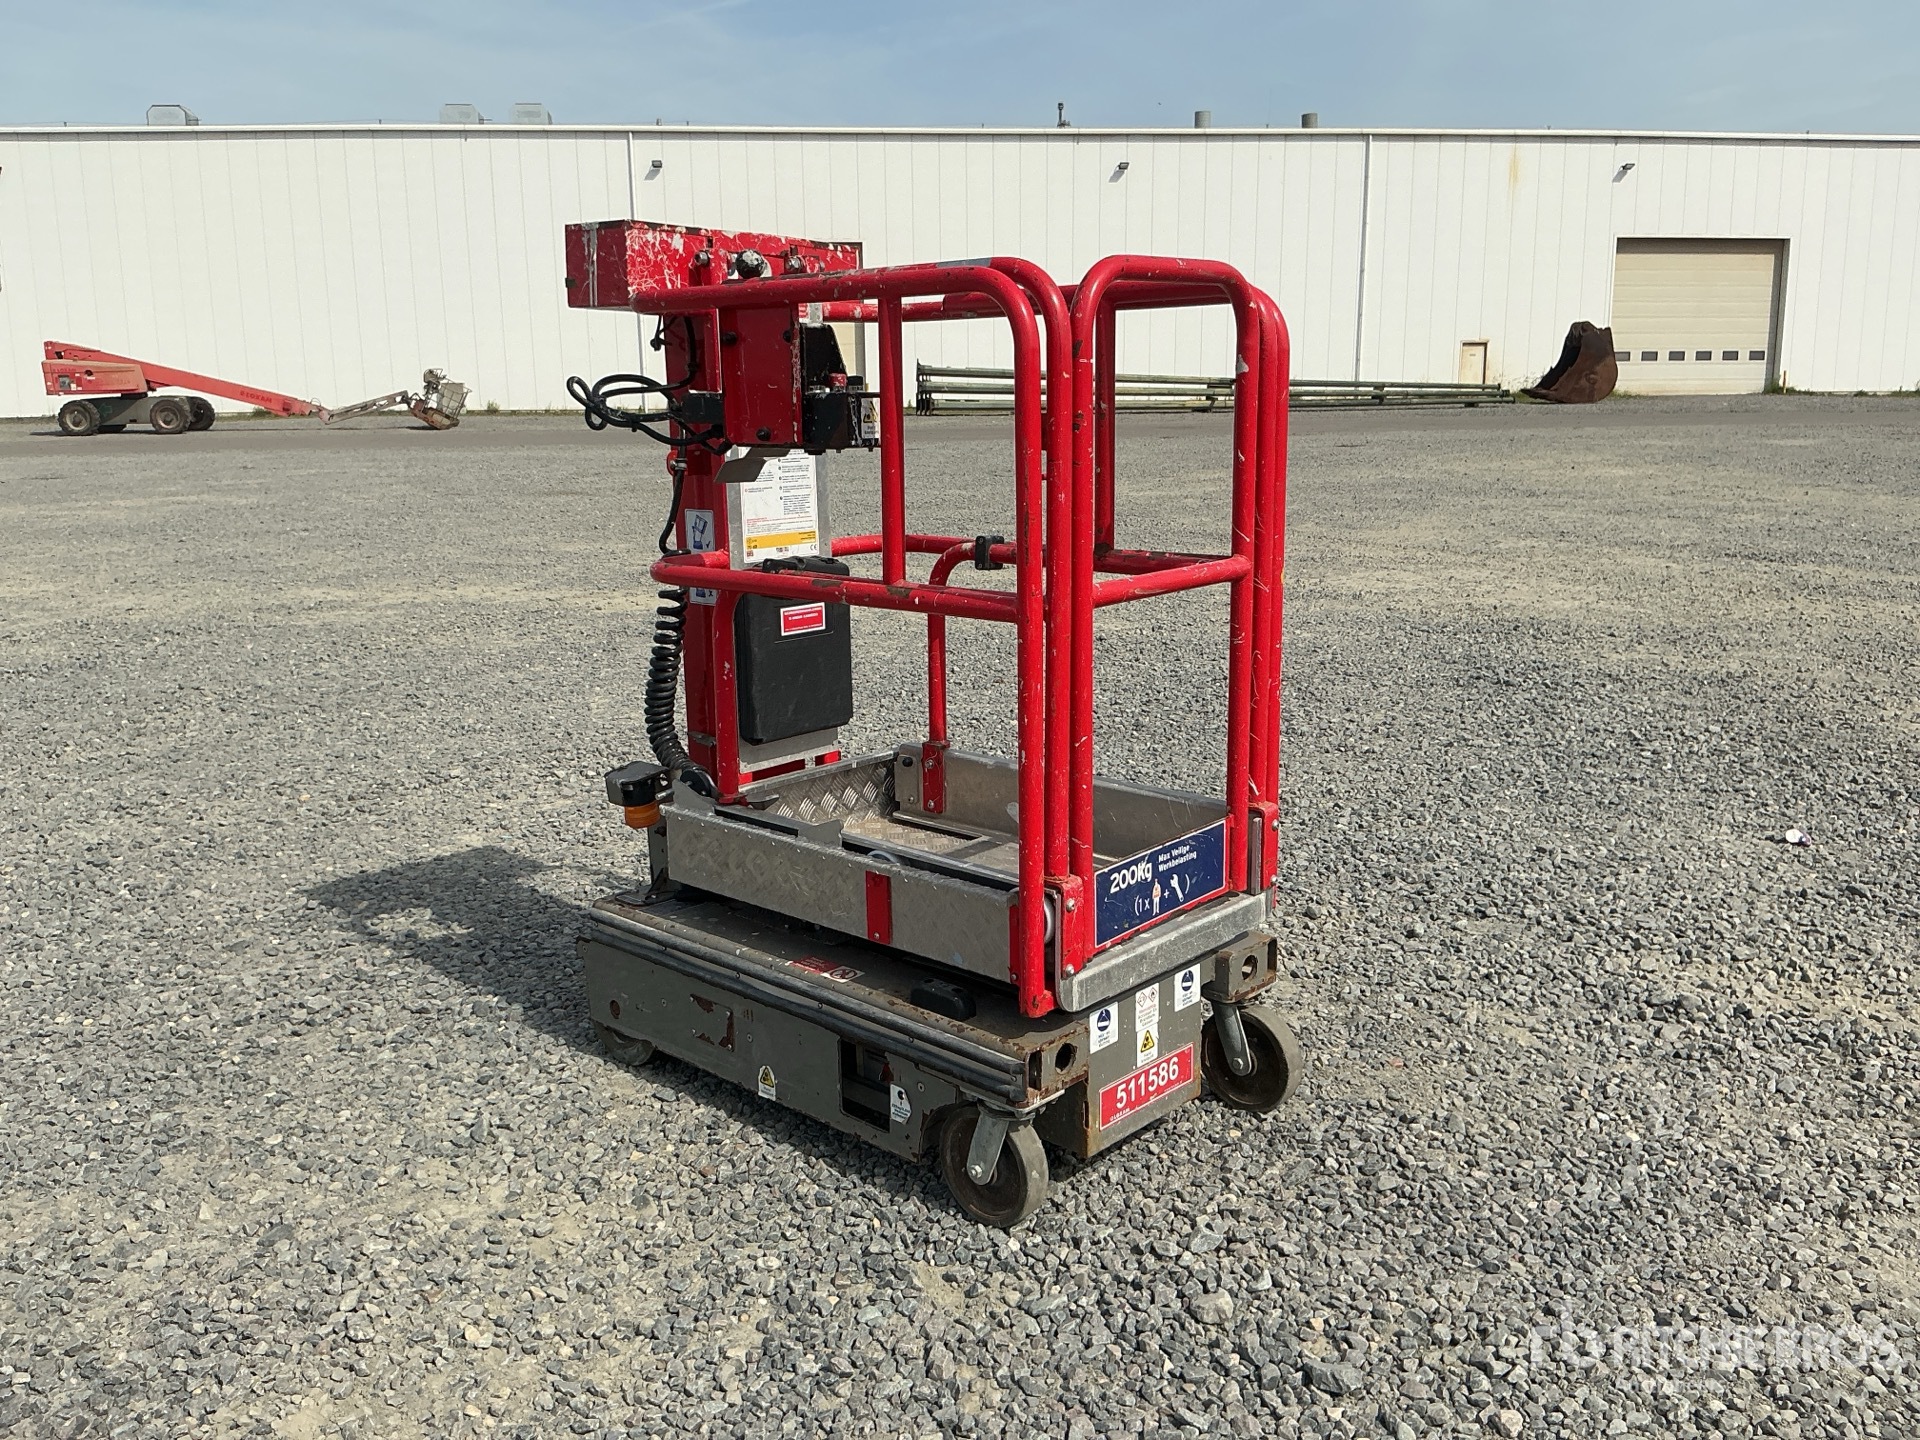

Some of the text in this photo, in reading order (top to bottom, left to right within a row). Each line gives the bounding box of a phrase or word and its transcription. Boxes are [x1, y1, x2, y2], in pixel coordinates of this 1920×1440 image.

[1158, 845, 1190, 863] Max Veilige
[1158, 851, 1197, 872] Werkbelasting
[1110, 861, 1153, 894] 200Kg
[1116, 1056, 1179, 1109] 511586
